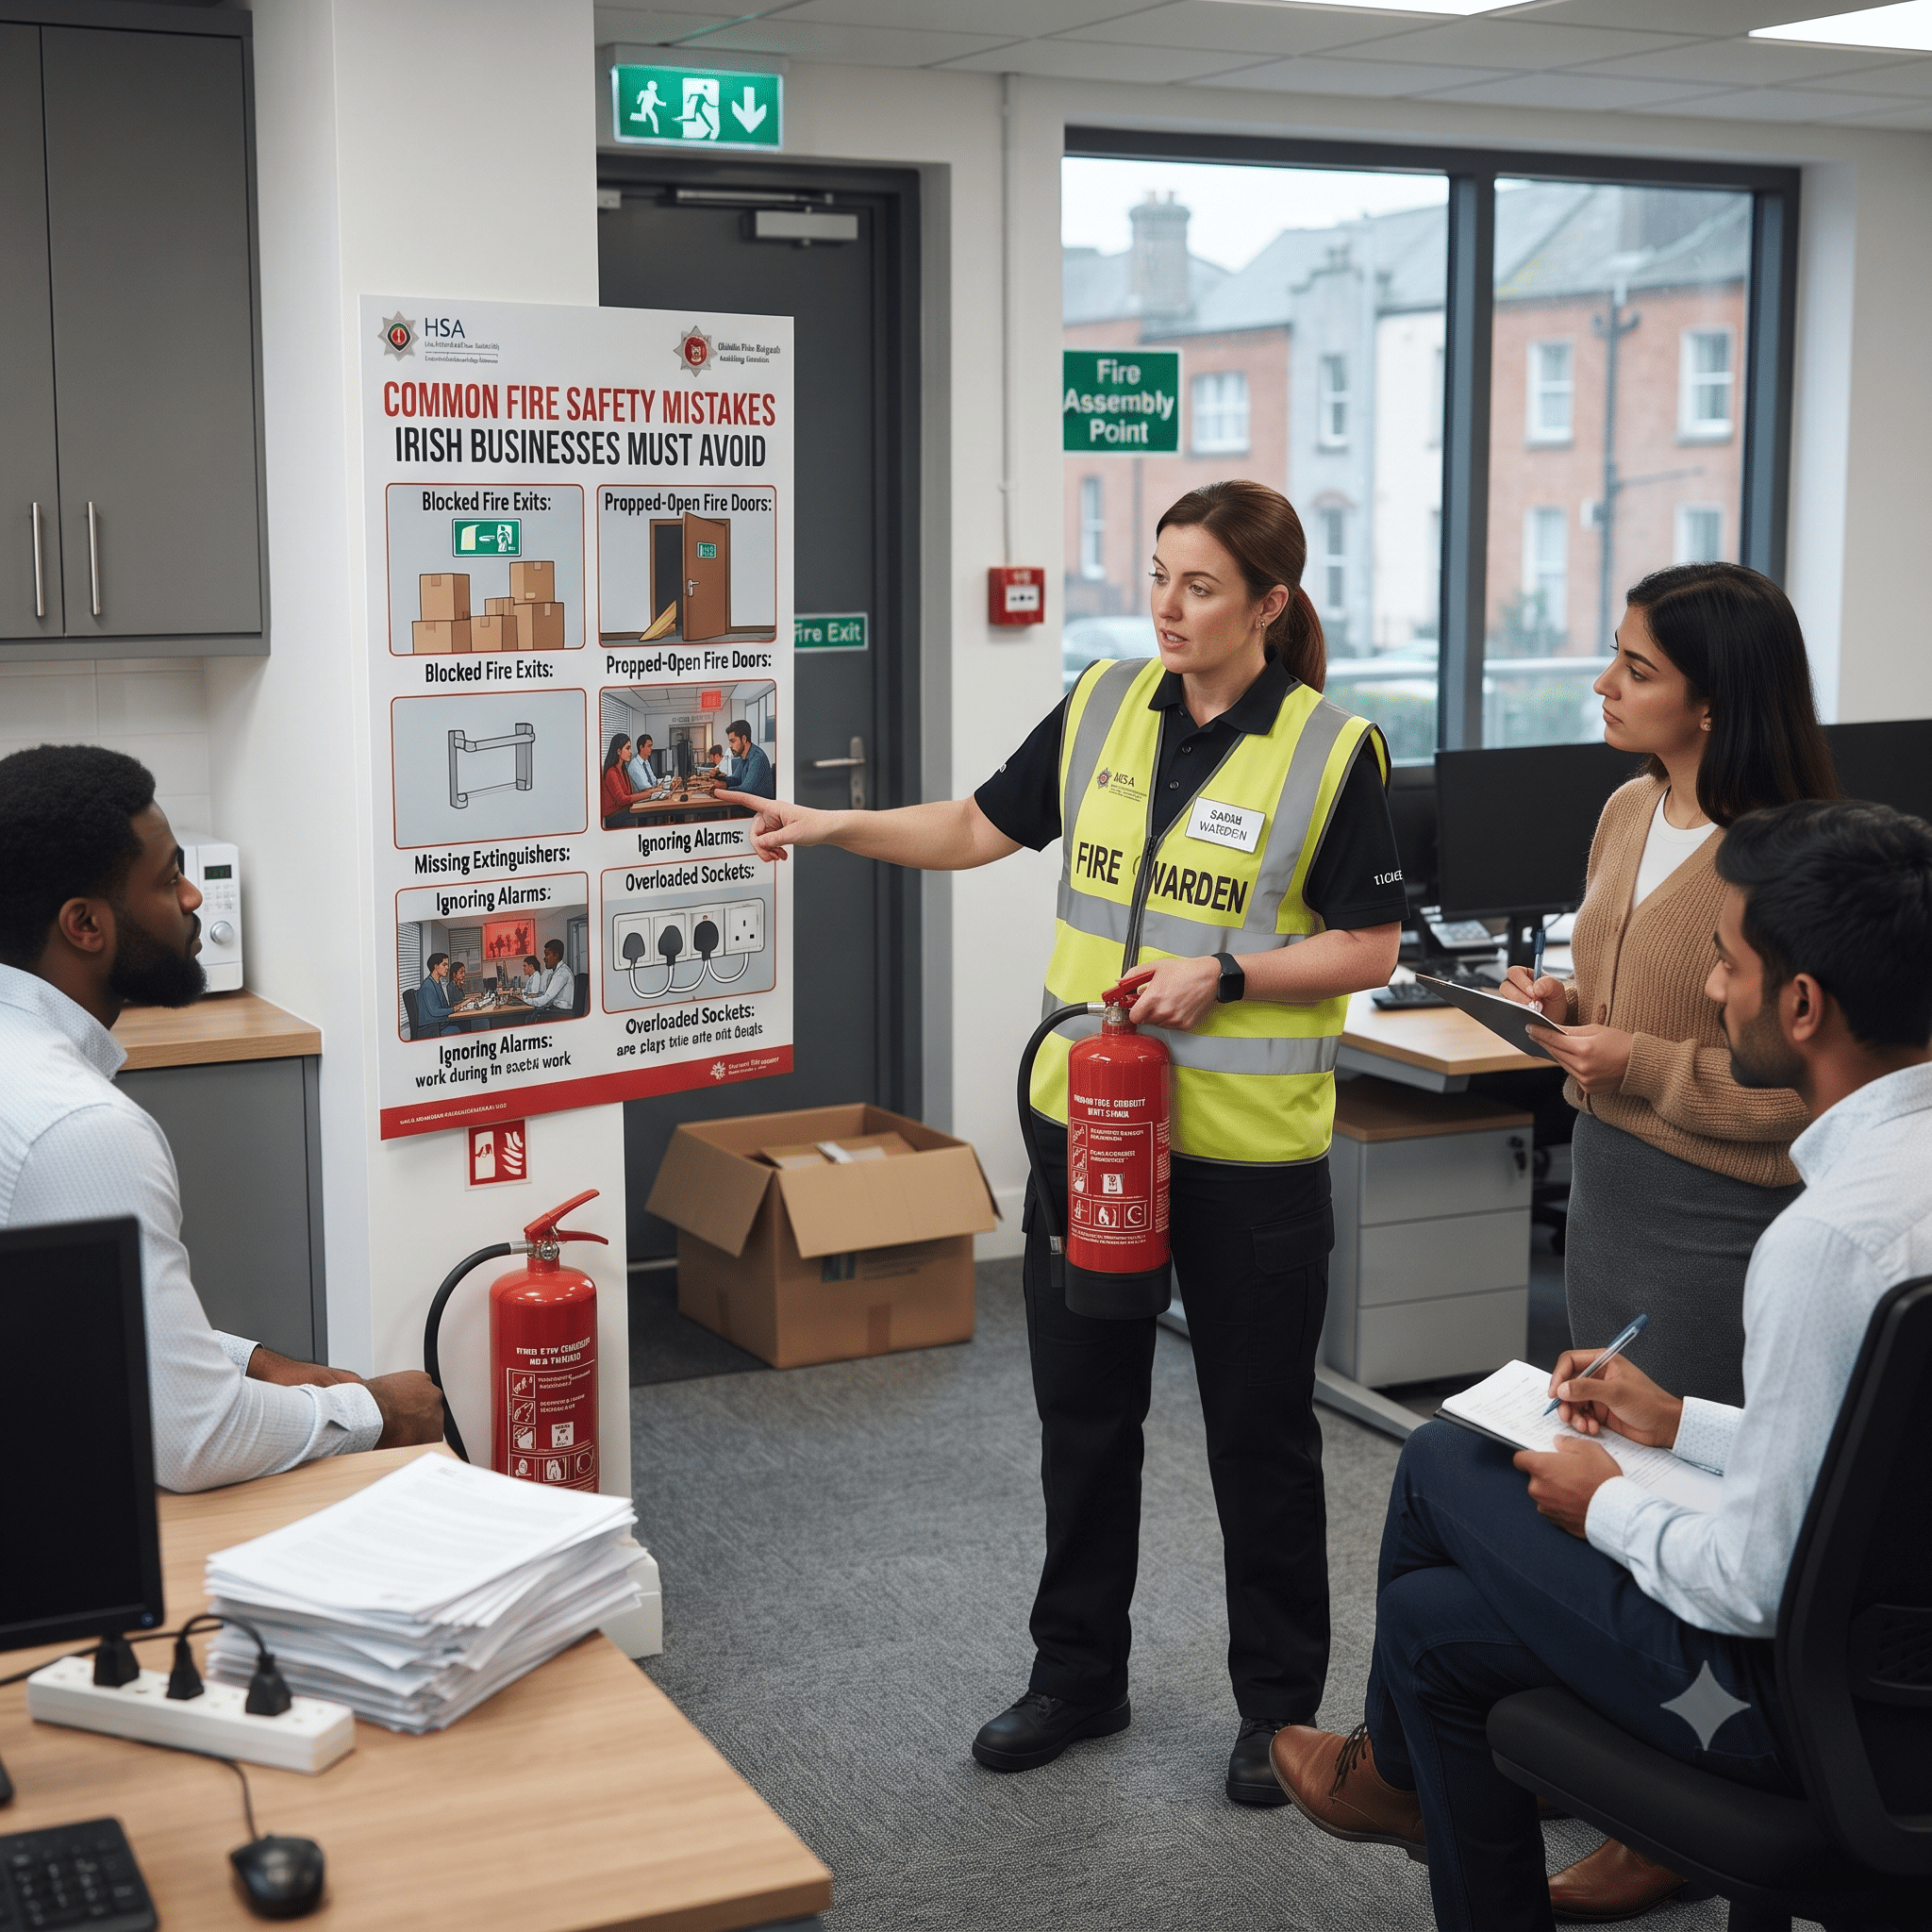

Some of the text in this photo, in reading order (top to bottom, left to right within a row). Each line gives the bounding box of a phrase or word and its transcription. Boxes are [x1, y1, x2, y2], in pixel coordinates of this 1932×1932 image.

[425, 317, 466, 339] HSA
[1097, 358, 1141, 385] Fire
[384, 380, 776, 426] COMMON FIRE SAFETY MISTAKES
[1063, 388, 1174, 421] Assembly
[1090, 418, 1149, 444] Point
[395, 426, 766, 467] IRISH BUSINESSES MUST AVOID
[422, 491, 552, 511] Blocked Fire Exits:
[704, 493, 728, 511] Fire
[732, 493, 772, 511] Doors:
[828, 622, 862, 642] Exit
[425, 659, 554, 683] Blocked Fire Exits:
[704, 652, 729, 670] Fire
[732, 650, 772, 668] Doors:
[638, 830, 691, 857] Ignoring
[414, 843, 571, 875] Missing Extinguishers:
[1076, 841, 1124, 885] FIRE
[625, 866, 698, 891] Overloaded
[436, 885, 552, 916] Ignoring Alarms:
[625, 1004, 756, 1035] Overloaded Sockets:
[440, 1033, 553, 1068] Ignoring Alarms:
[415, 1069, 446, 1088] work
[450, 1065, 488, 1084] during
[542, 1050, 572, 1069] work
